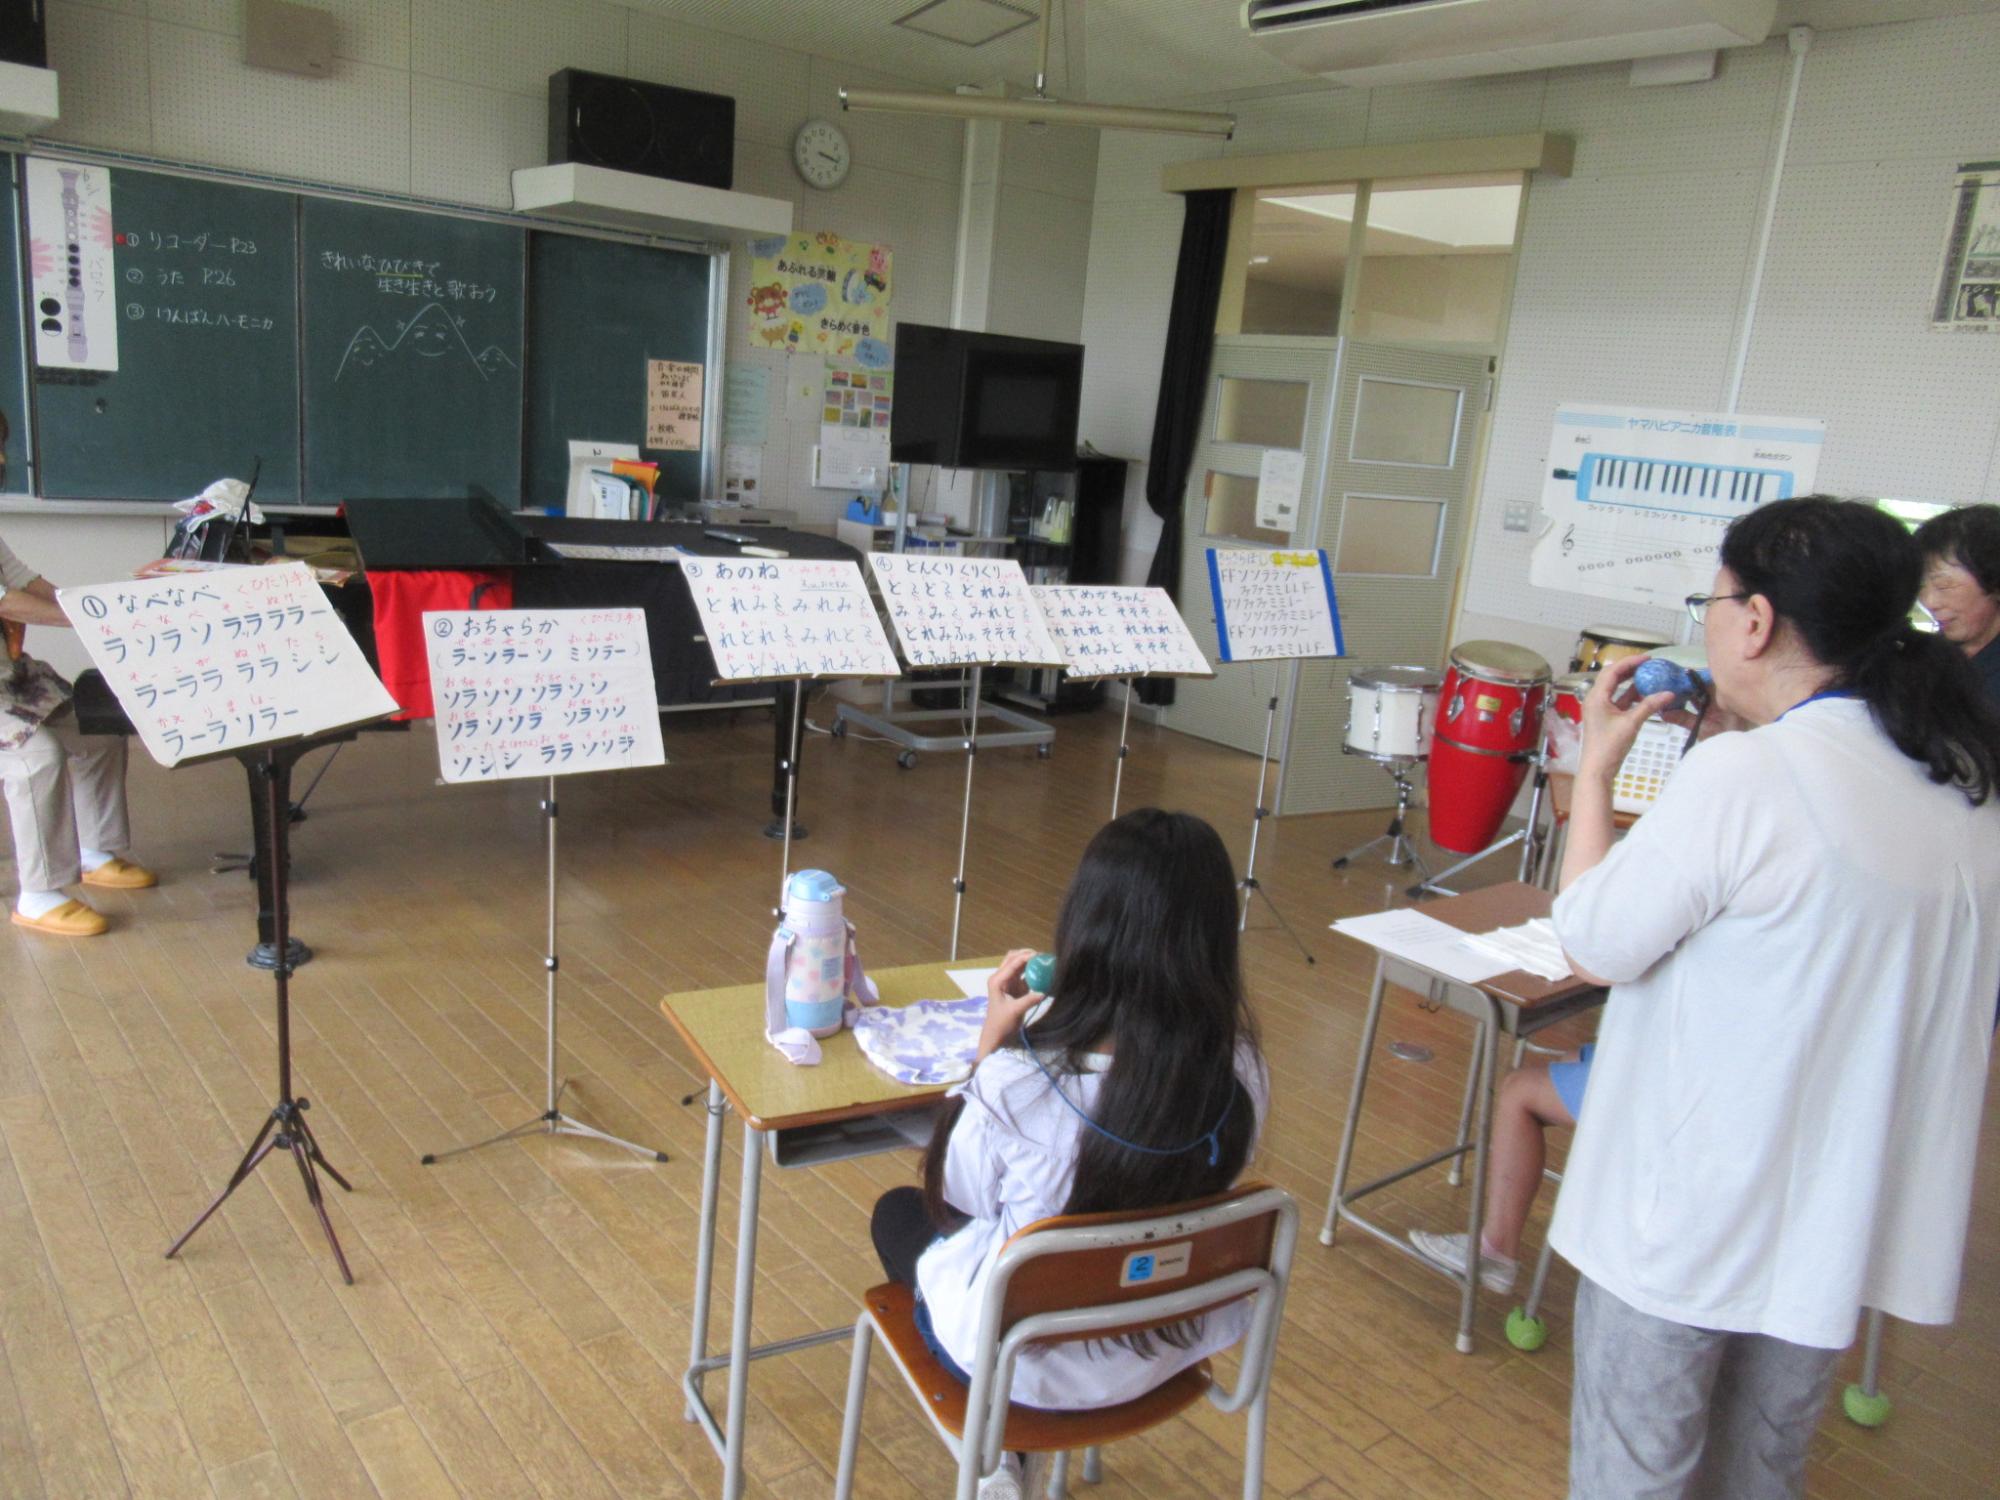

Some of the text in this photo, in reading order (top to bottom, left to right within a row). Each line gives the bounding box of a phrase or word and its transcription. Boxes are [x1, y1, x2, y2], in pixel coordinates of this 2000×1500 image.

[715, 560, 780, 580] あのね
[117, 584, 221, 614] なべなべ
[434, 617, 453, 637] ②
[463, 615, 560, 637] おちゃらか
[1136, 1256, 1150, 1272] 2
